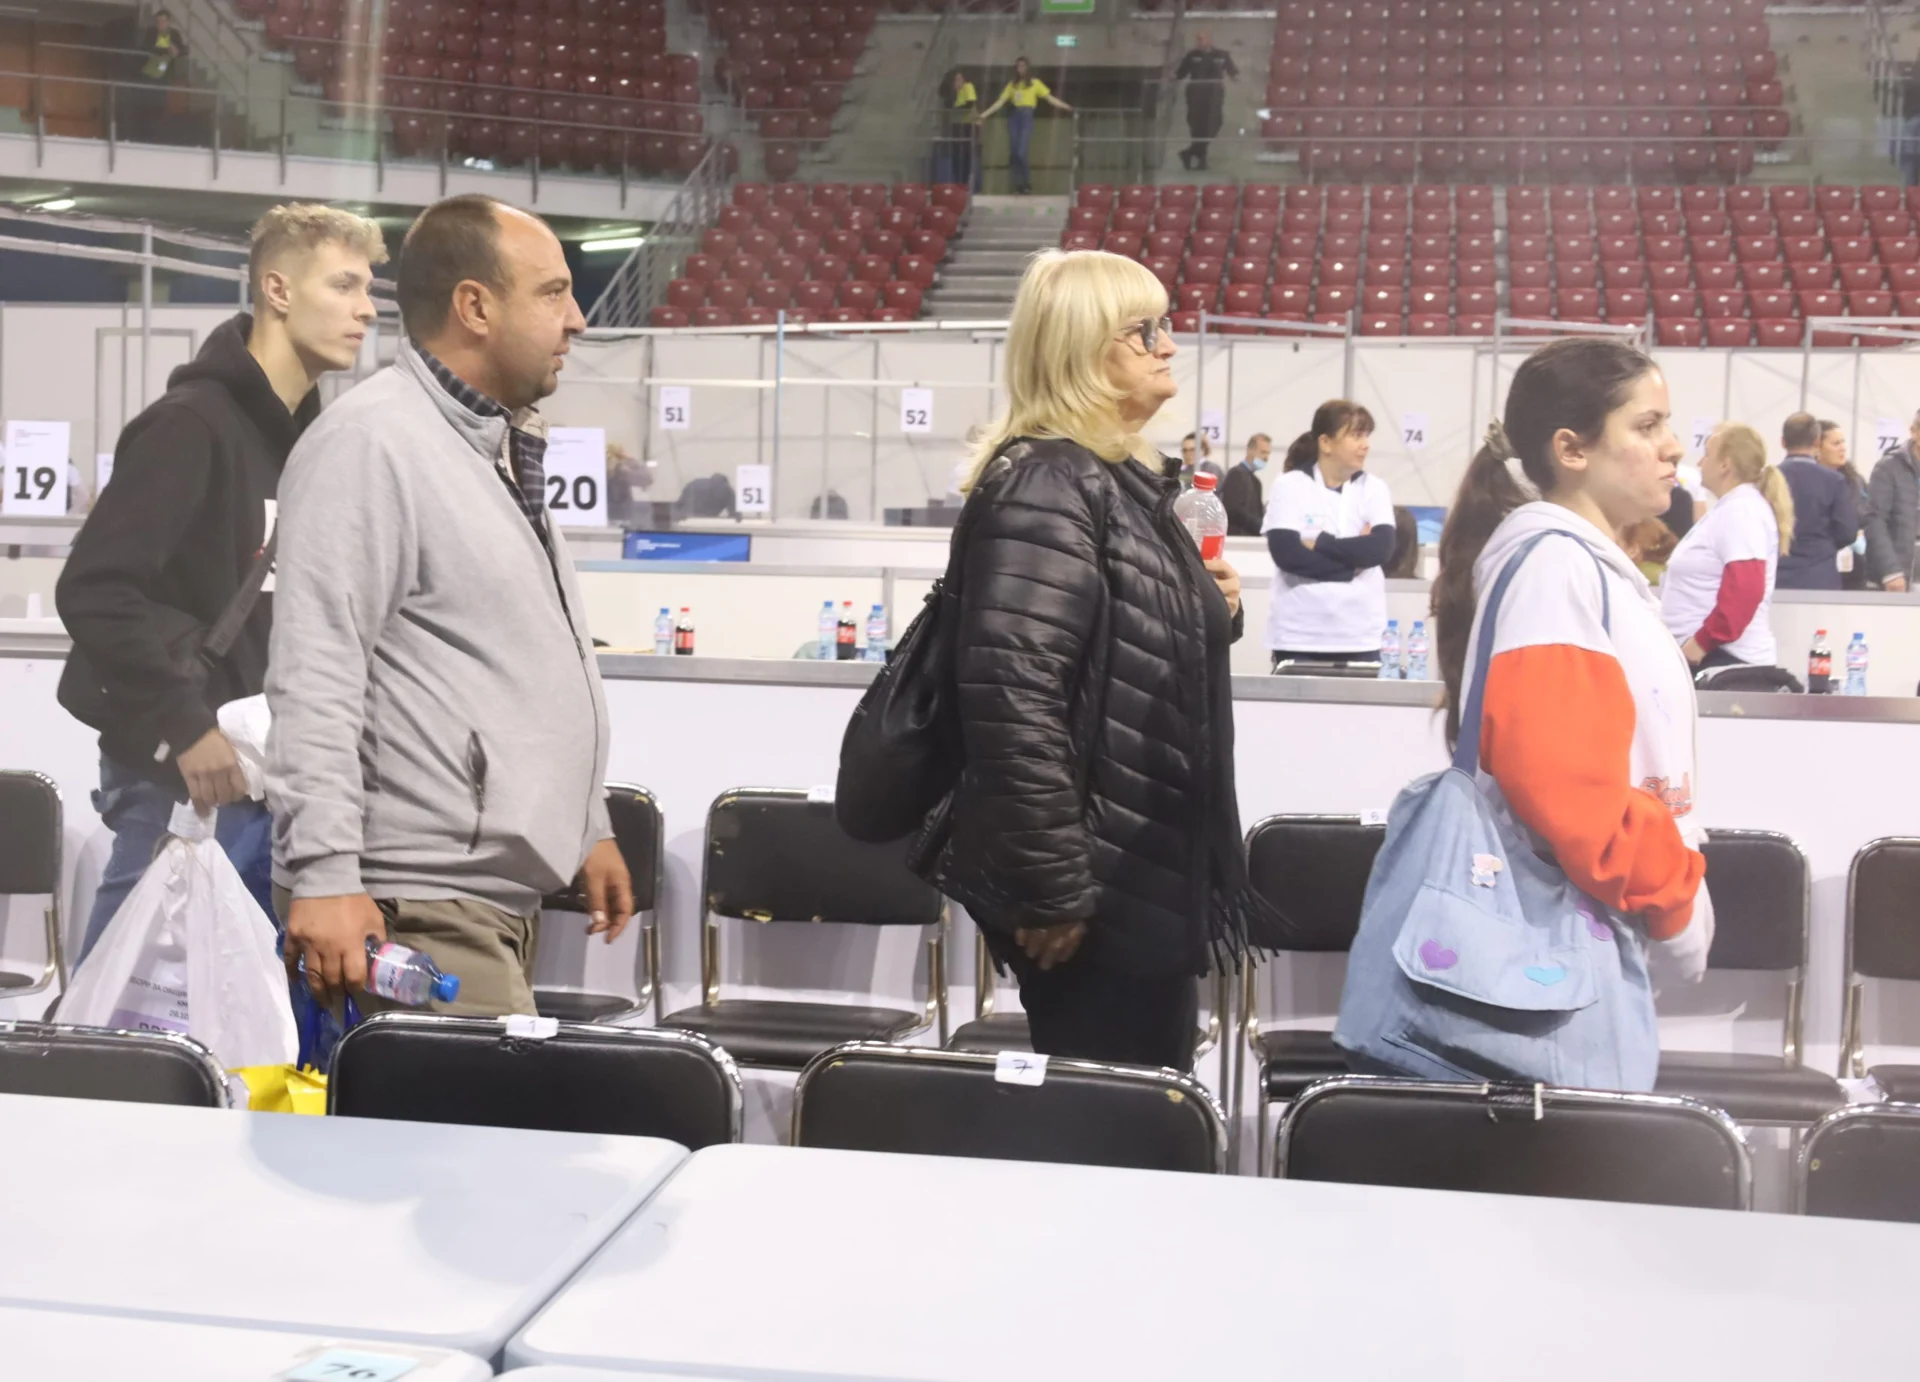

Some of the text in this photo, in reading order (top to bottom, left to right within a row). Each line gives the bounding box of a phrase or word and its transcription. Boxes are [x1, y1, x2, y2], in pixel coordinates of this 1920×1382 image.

[664, 406, 685, 423] 51
[906, 409, 928, 426] 52
[1201, 425, 1220, 441] 73
[1404, 428, 1424, 444] 74
[14, 465, 57, 501] 19
[546, 474, 598, 511] 20
[742, 487, 765, 505] 51
[1011, 1058, 1034, 1077] 7
